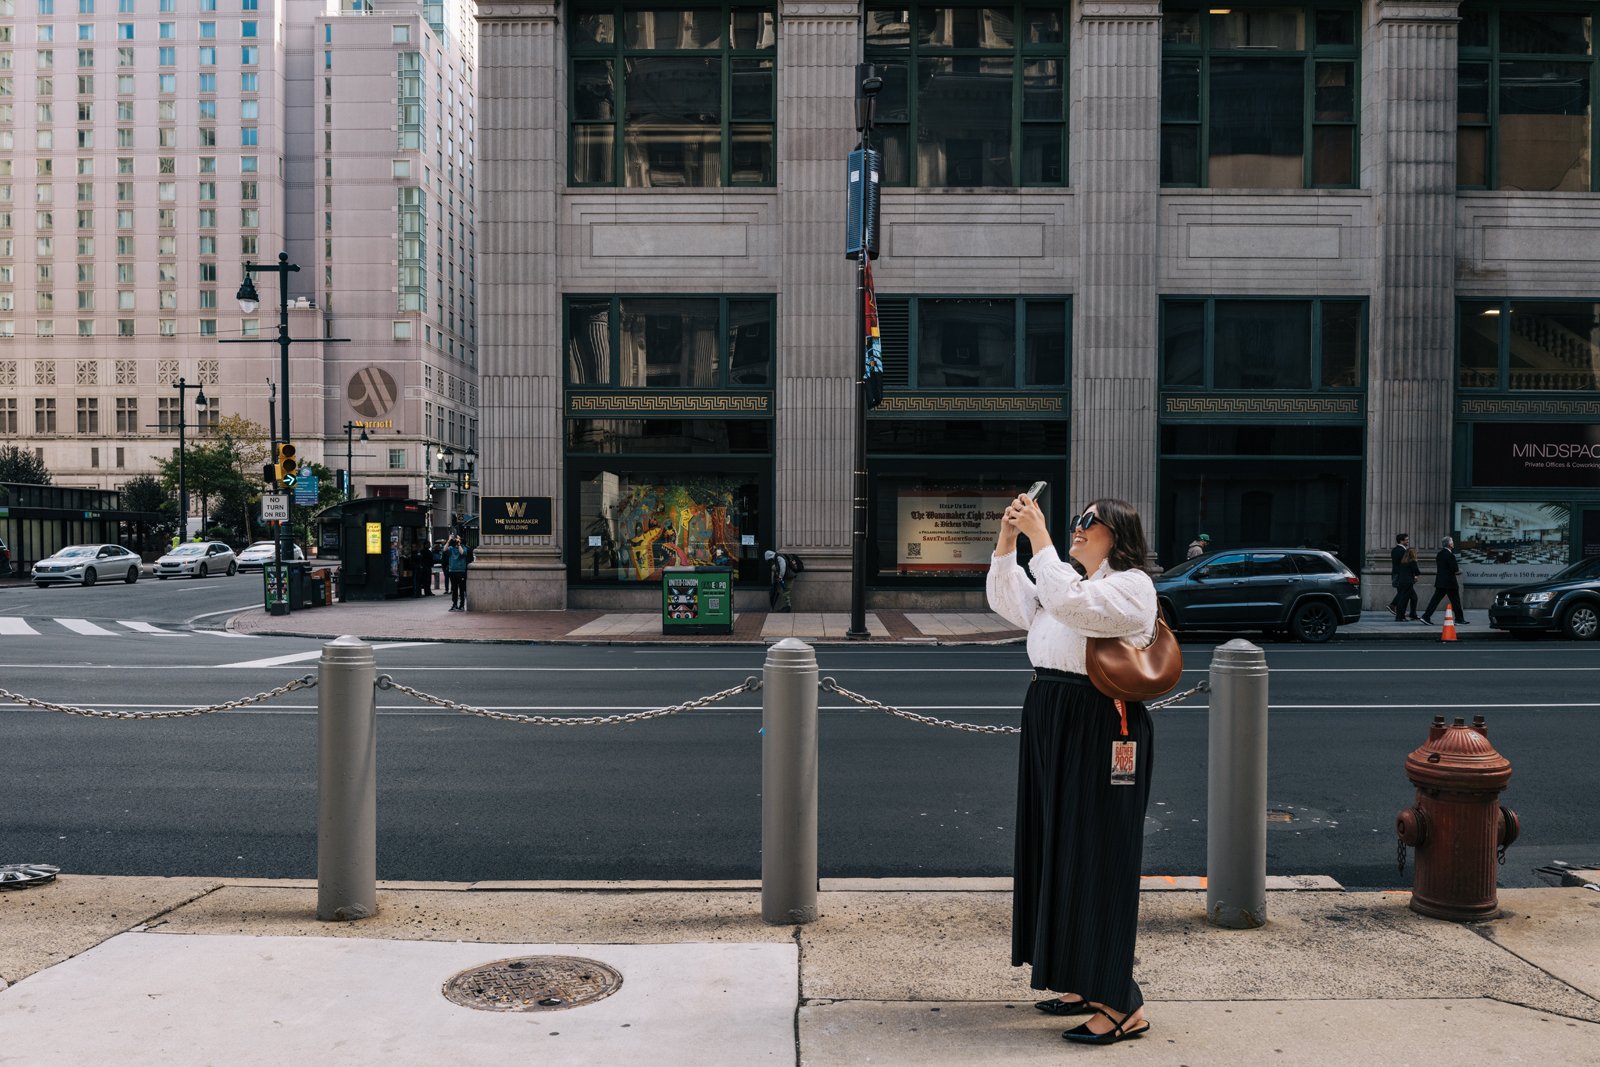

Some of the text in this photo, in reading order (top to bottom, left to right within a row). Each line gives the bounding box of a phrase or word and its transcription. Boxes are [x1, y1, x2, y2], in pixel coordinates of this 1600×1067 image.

[911, 511, 925, 520] The
[925, 511, 965, 520] Wanamaker
[966, 511, 985, 521] Light
[1498, 571, 1513, 579] office
